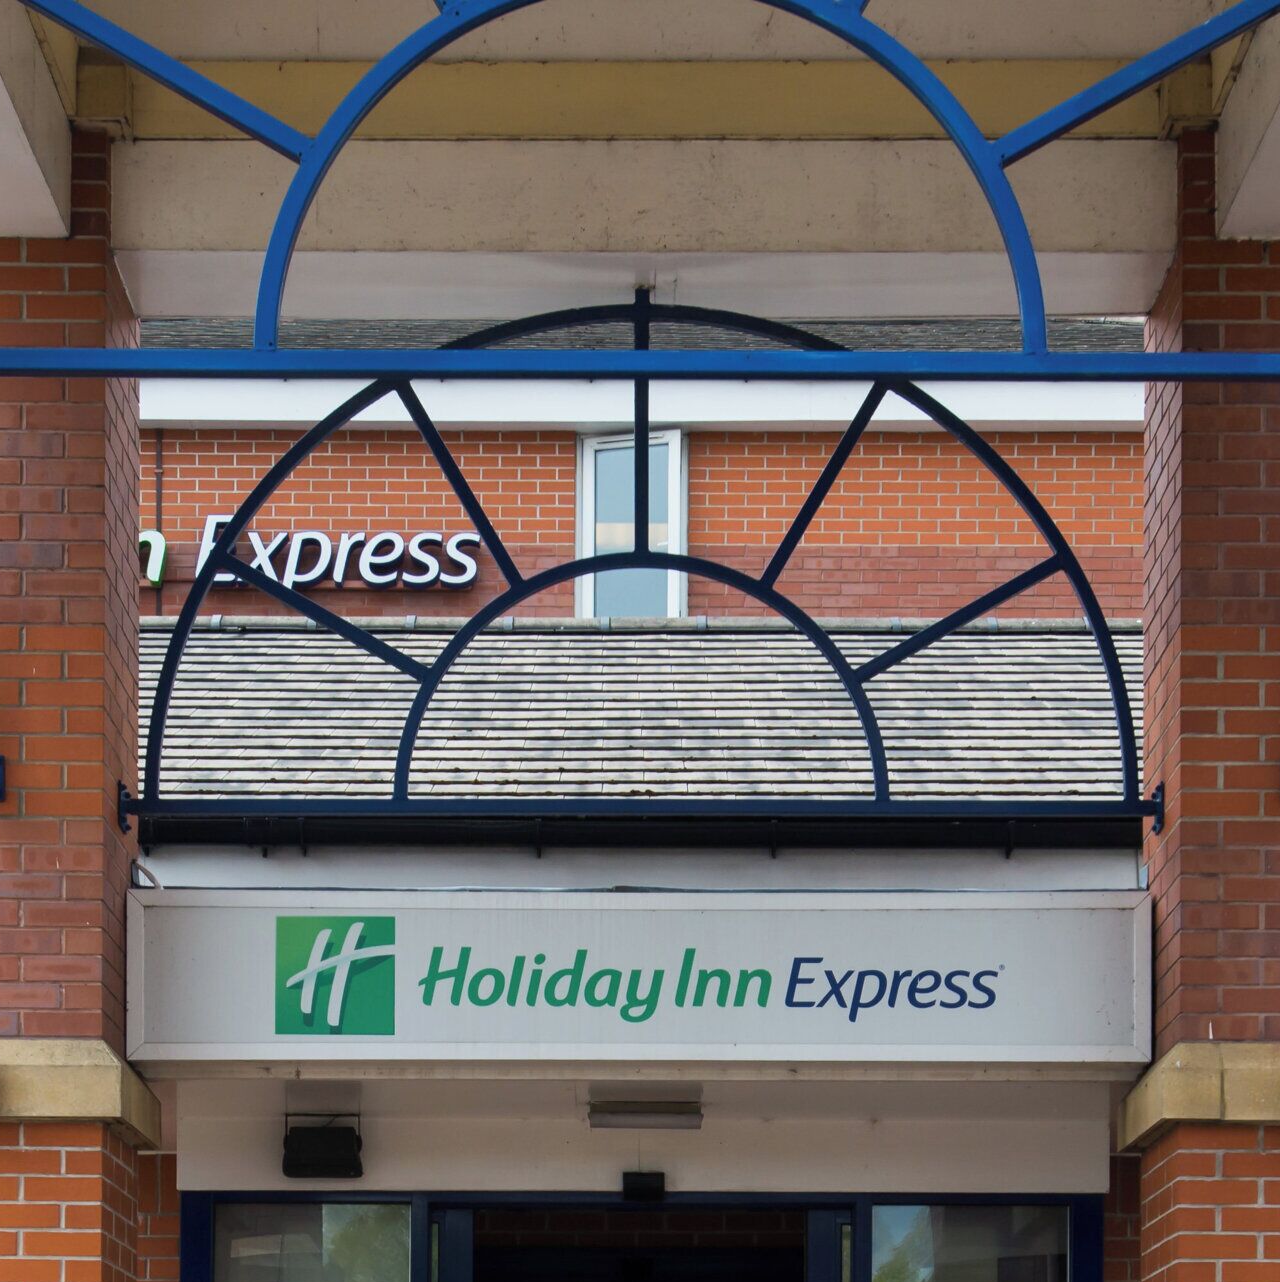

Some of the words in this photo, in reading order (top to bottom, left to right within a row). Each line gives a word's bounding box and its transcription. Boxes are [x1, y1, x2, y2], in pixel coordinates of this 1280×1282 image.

[195, 514, 481, 589] Express
[418, 946, 665, 1023] Holiday
[674, 948, 772, 1008] Inn
[785, 957, 999, 1023] Express
